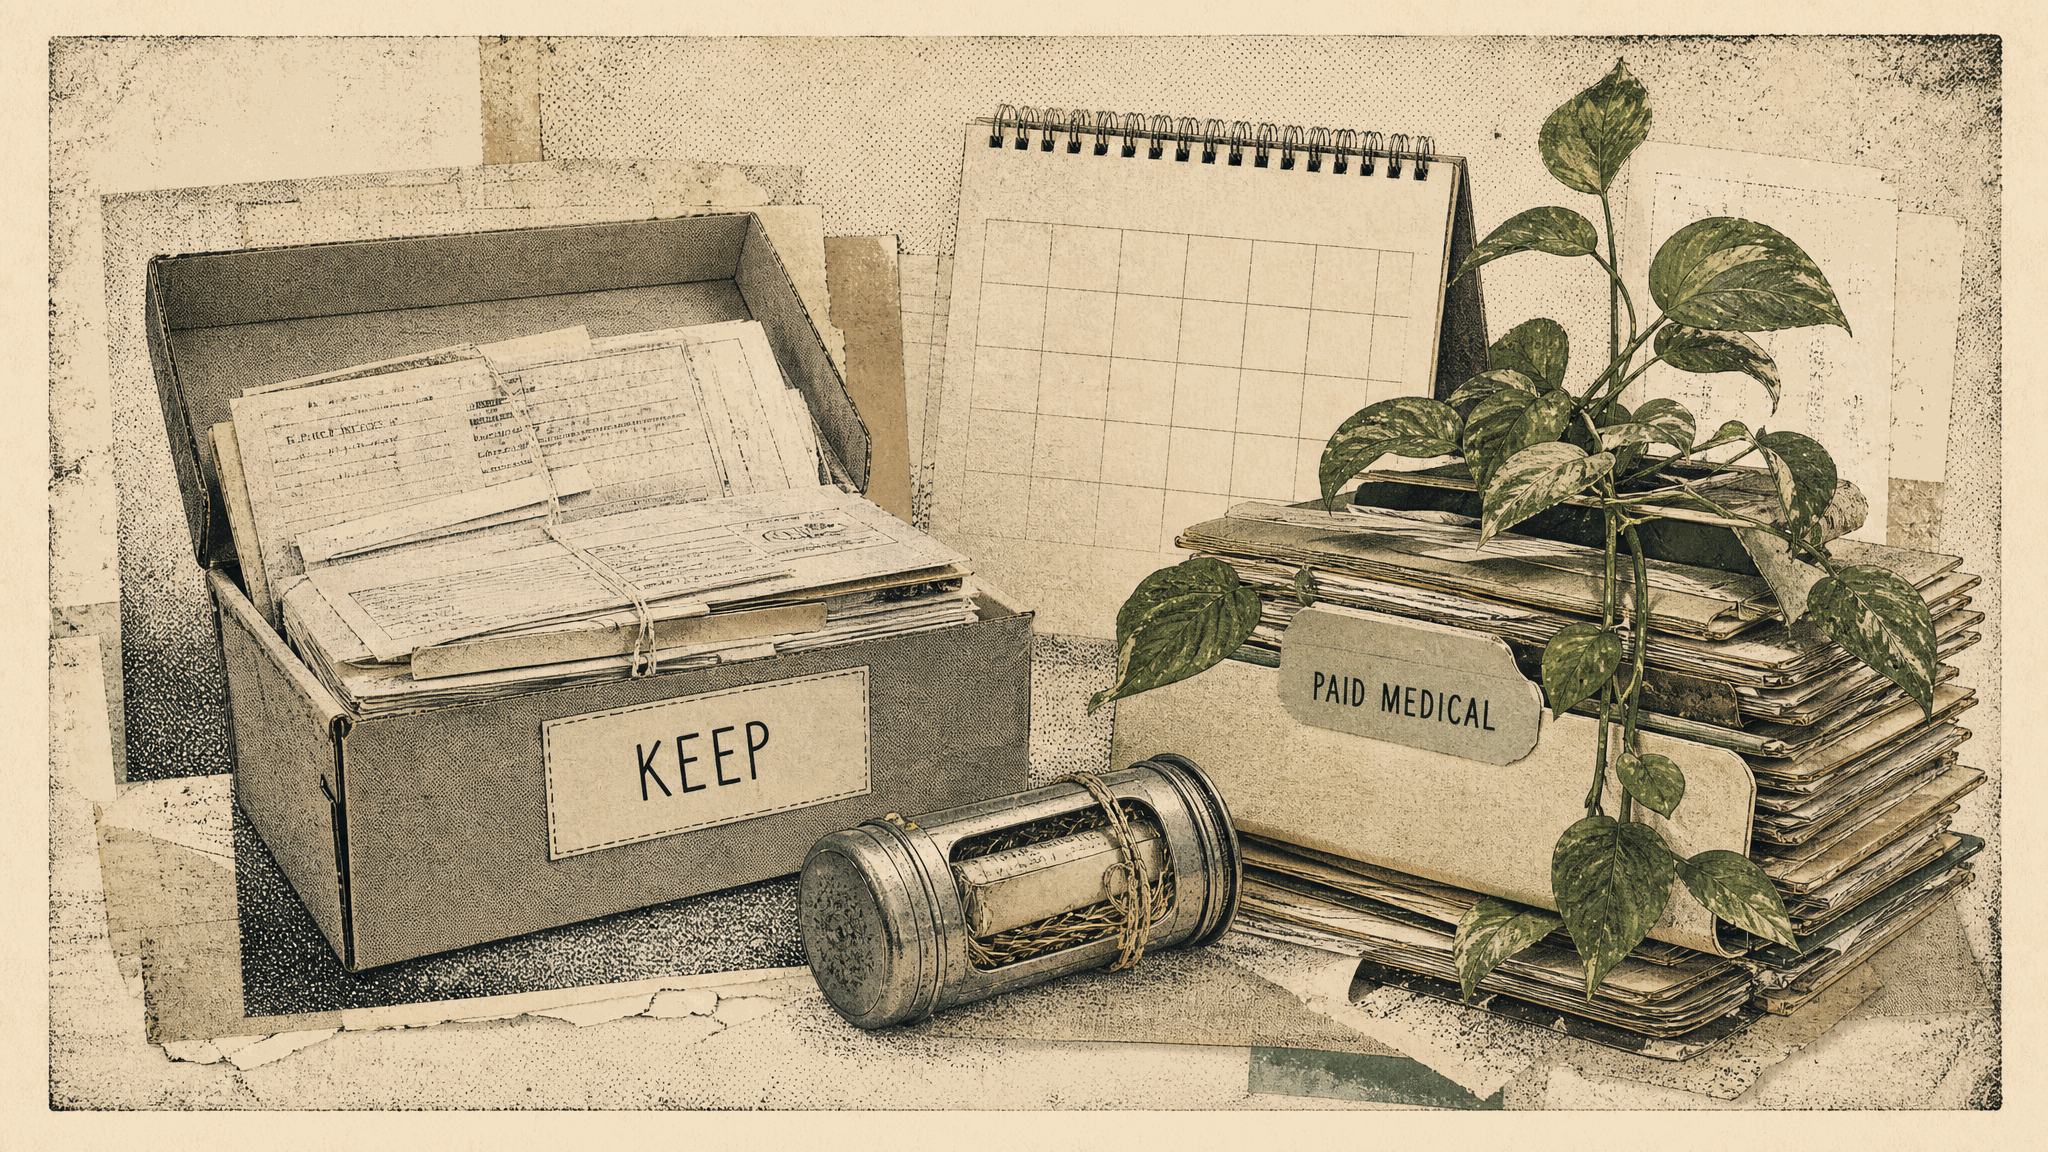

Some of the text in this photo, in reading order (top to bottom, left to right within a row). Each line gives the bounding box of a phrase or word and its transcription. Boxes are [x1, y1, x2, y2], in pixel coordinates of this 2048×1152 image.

[1313, 671, 1495, 731] PAID MEDICAL
[636, 720, 770, 801] KEEP
